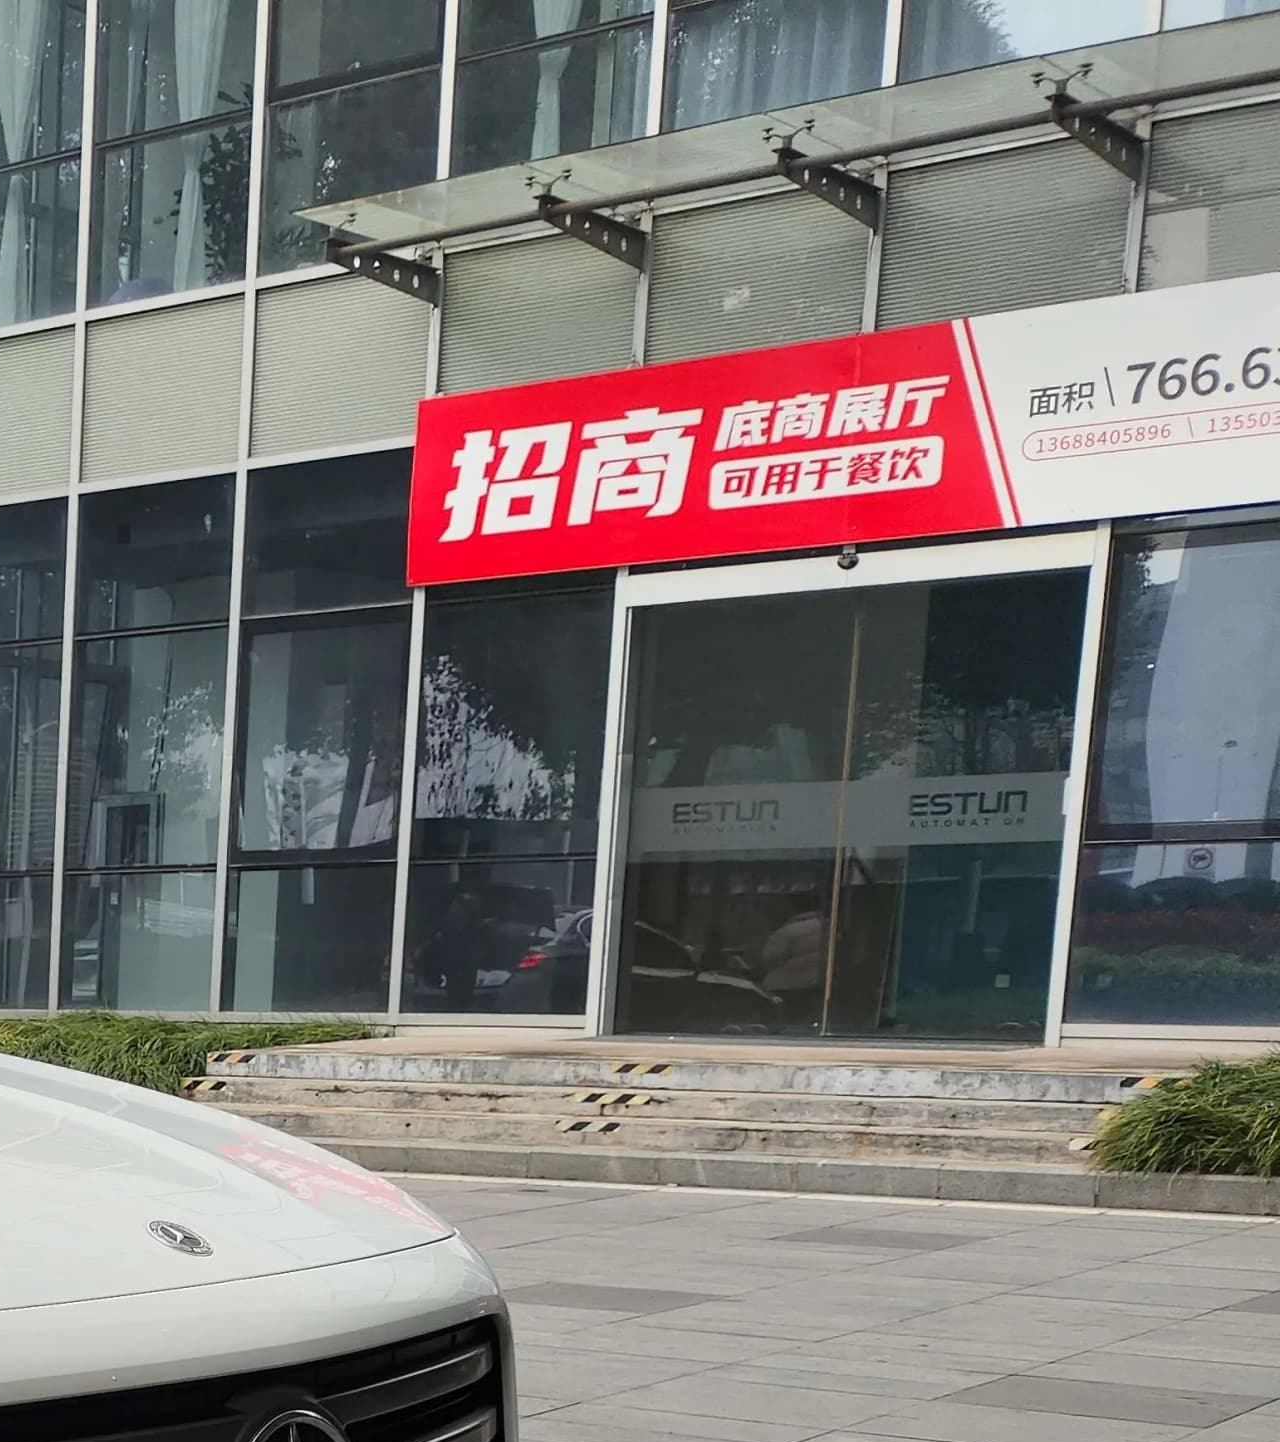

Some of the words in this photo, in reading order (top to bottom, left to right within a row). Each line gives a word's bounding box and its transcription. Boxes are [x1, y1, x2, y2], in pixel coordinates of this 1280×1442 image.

[1126, 346, 1280, 405] 766.6
[713, 375, 950, 452] 底商展厅
[1029, 381, 1096, 418] 面积
[1035, 423, 1172, 453] 13688405896
[438, 408, 704, 543] 招商
[723, 446, 930, 499] 可用于餐饮
[672, 800, 779, 824] ESTUN
[909, 789, 1028, 816] ESTUN
[910, 817, 1025, 829] AUTOMATON
